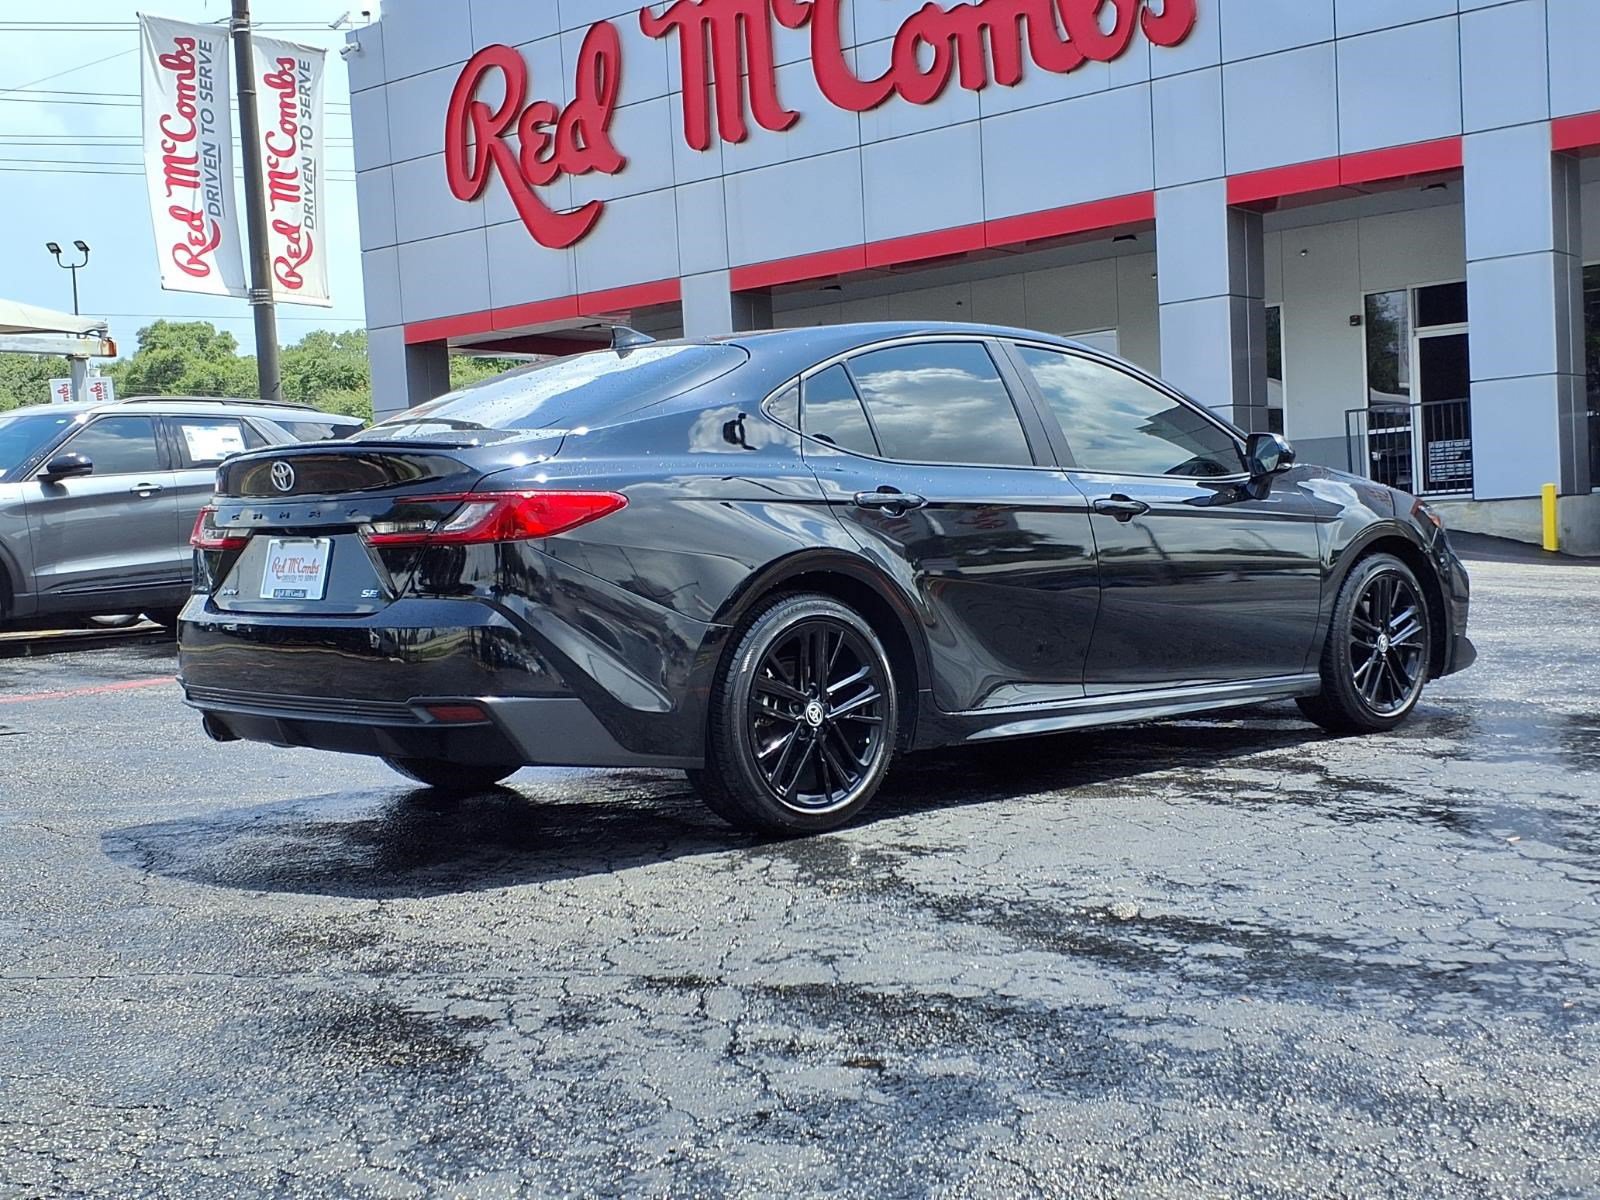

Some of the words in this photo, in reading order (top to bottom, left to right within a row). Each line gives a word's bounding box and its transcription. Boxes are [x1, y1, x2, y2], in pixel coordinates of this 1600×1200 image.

[199, 39, 214, 103] SERVE
[298, 60, 312, 122] SERVE
[159, 37, 201, 198] McCombs
[201, 108, 215, 135] TO
[264, 57, 301, 212] McCombs
[300, 125, 313, 148] TO
[446, 22, 628, 248] Red
[203, 144, 221, 217] DRIVEN
[302, 159, 316, 229] DRIVEN
[170, 205, 221, 278] Red
[272, 219, 313, 290] Red
[361, 589, 378, 598] SE
